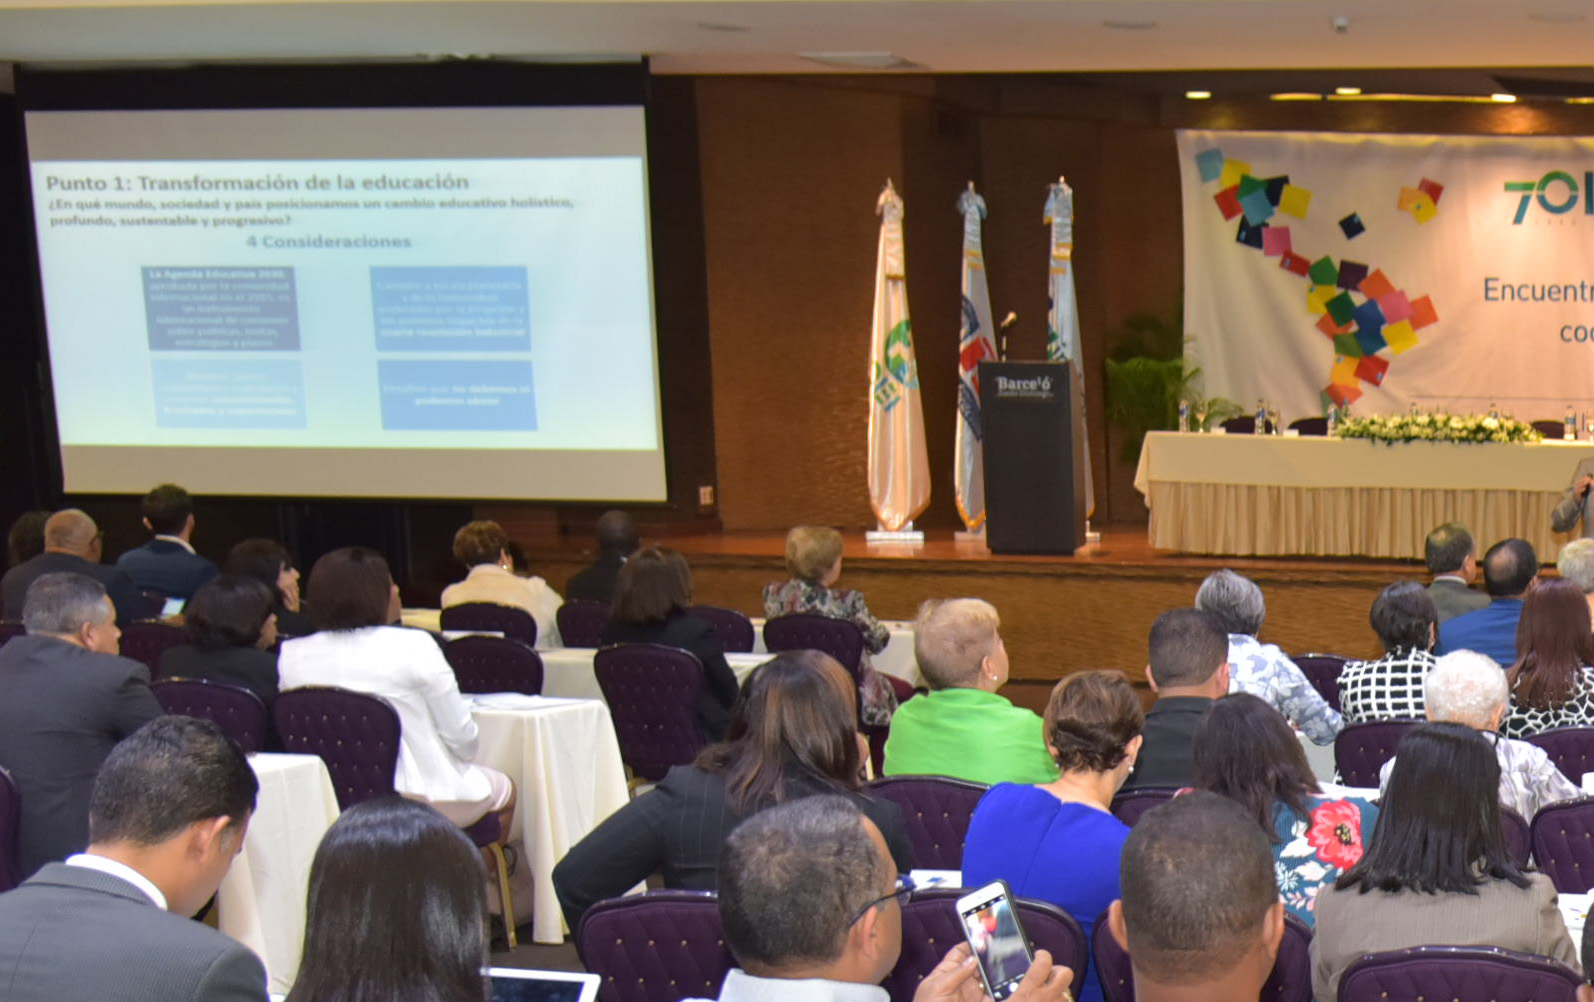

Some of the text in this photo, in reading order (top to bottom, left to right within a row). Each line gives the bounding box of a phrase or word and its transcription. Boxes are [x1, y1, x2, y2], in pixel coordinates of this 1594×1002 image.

[46, 172, 470, 191] Punto 1: Transformación de la educación
[160, 198, 219, 209] sociedad
[224, 201, 231, 211] y
[265, 198, 359, 210] posicionamos
[363, 200, 381, 209] un
[384, 198, 436, 209] cambio
[439, 197, 507, 209] educativo
[120, 215, 196, 226] sustentable
[202, 218, 209, 227] y
[246, 233, 412, 248] 4 Consideraciones
